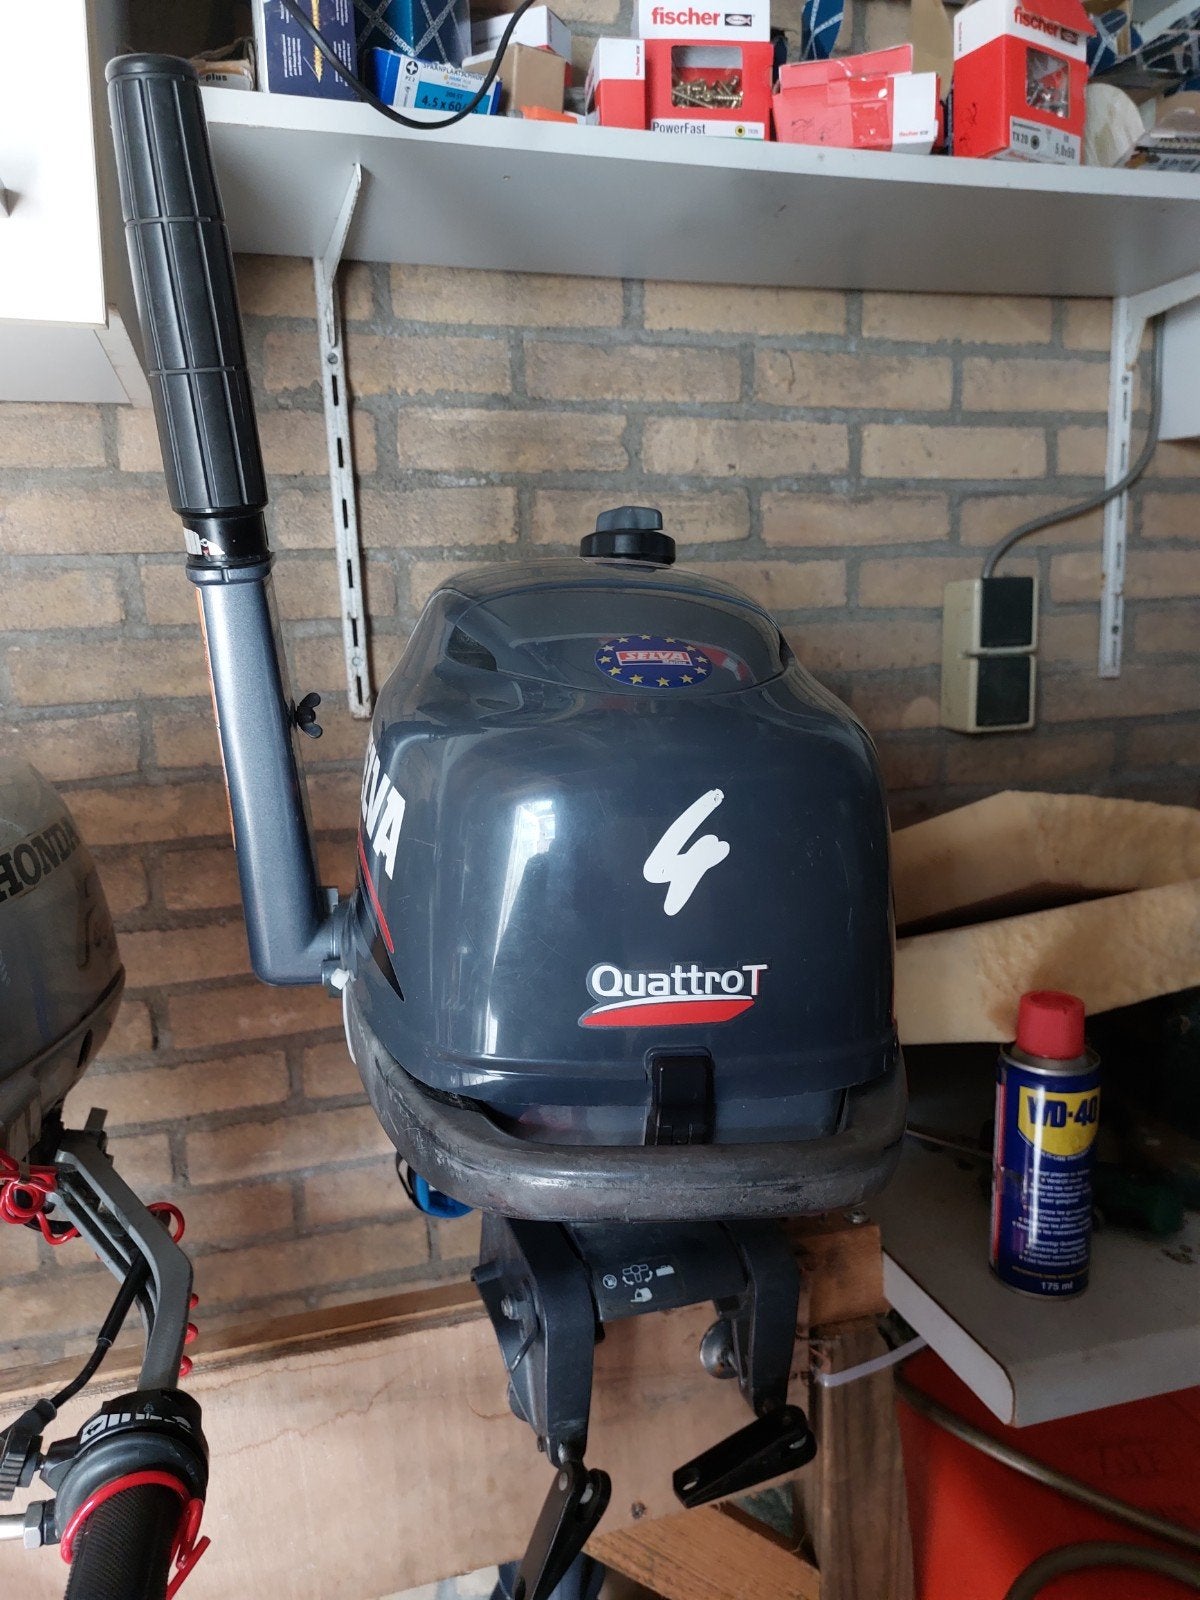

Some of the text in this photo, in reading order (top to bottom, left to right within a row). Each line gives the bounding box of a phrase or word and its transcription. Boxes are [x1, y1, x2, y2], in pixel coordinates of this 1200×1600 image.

[651, 7, 721, 26] fischer
[1013, 5, 1060, 37] fischer
[652, 121, 706, 135] PowerFast
[624, 651, 686, 661] SELVA
[0, 817, 82, 903] HONDA
[643, 788, 731, 917] 4
[1026, 1094, 1099, 1128] WD-40
[1041, 1280, 1074, 1290] 175 ml
